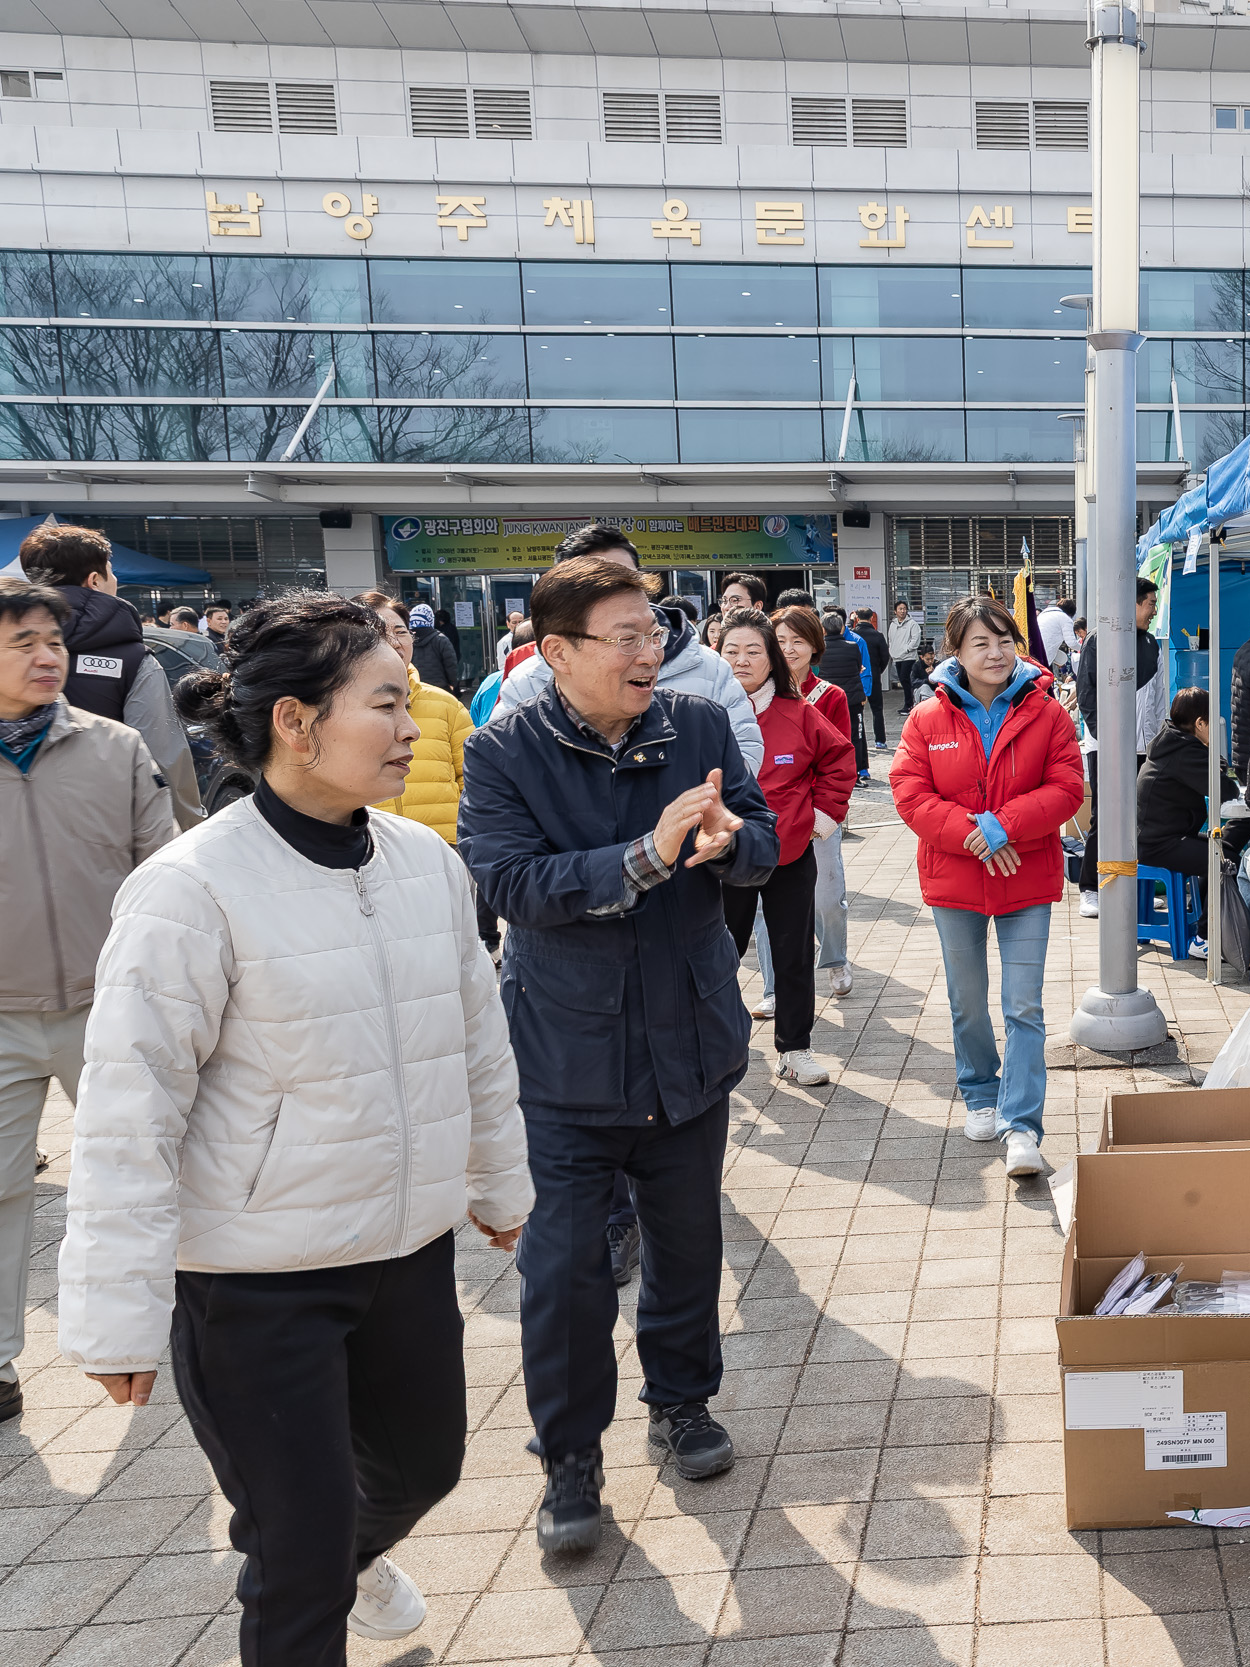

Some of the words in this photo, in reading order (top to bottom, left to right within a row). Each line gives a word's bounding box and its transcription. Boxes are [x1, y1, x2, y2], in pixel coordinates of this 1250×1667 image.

[424, 518, 499, 536] 광진구협회와
[503, 521, 530, 537] JUNG
[532, 520, 564, 536] KWAN
[649, 519, 684, 532] 함께하는
[687, 516, 760, 532] 배드민턴대회
